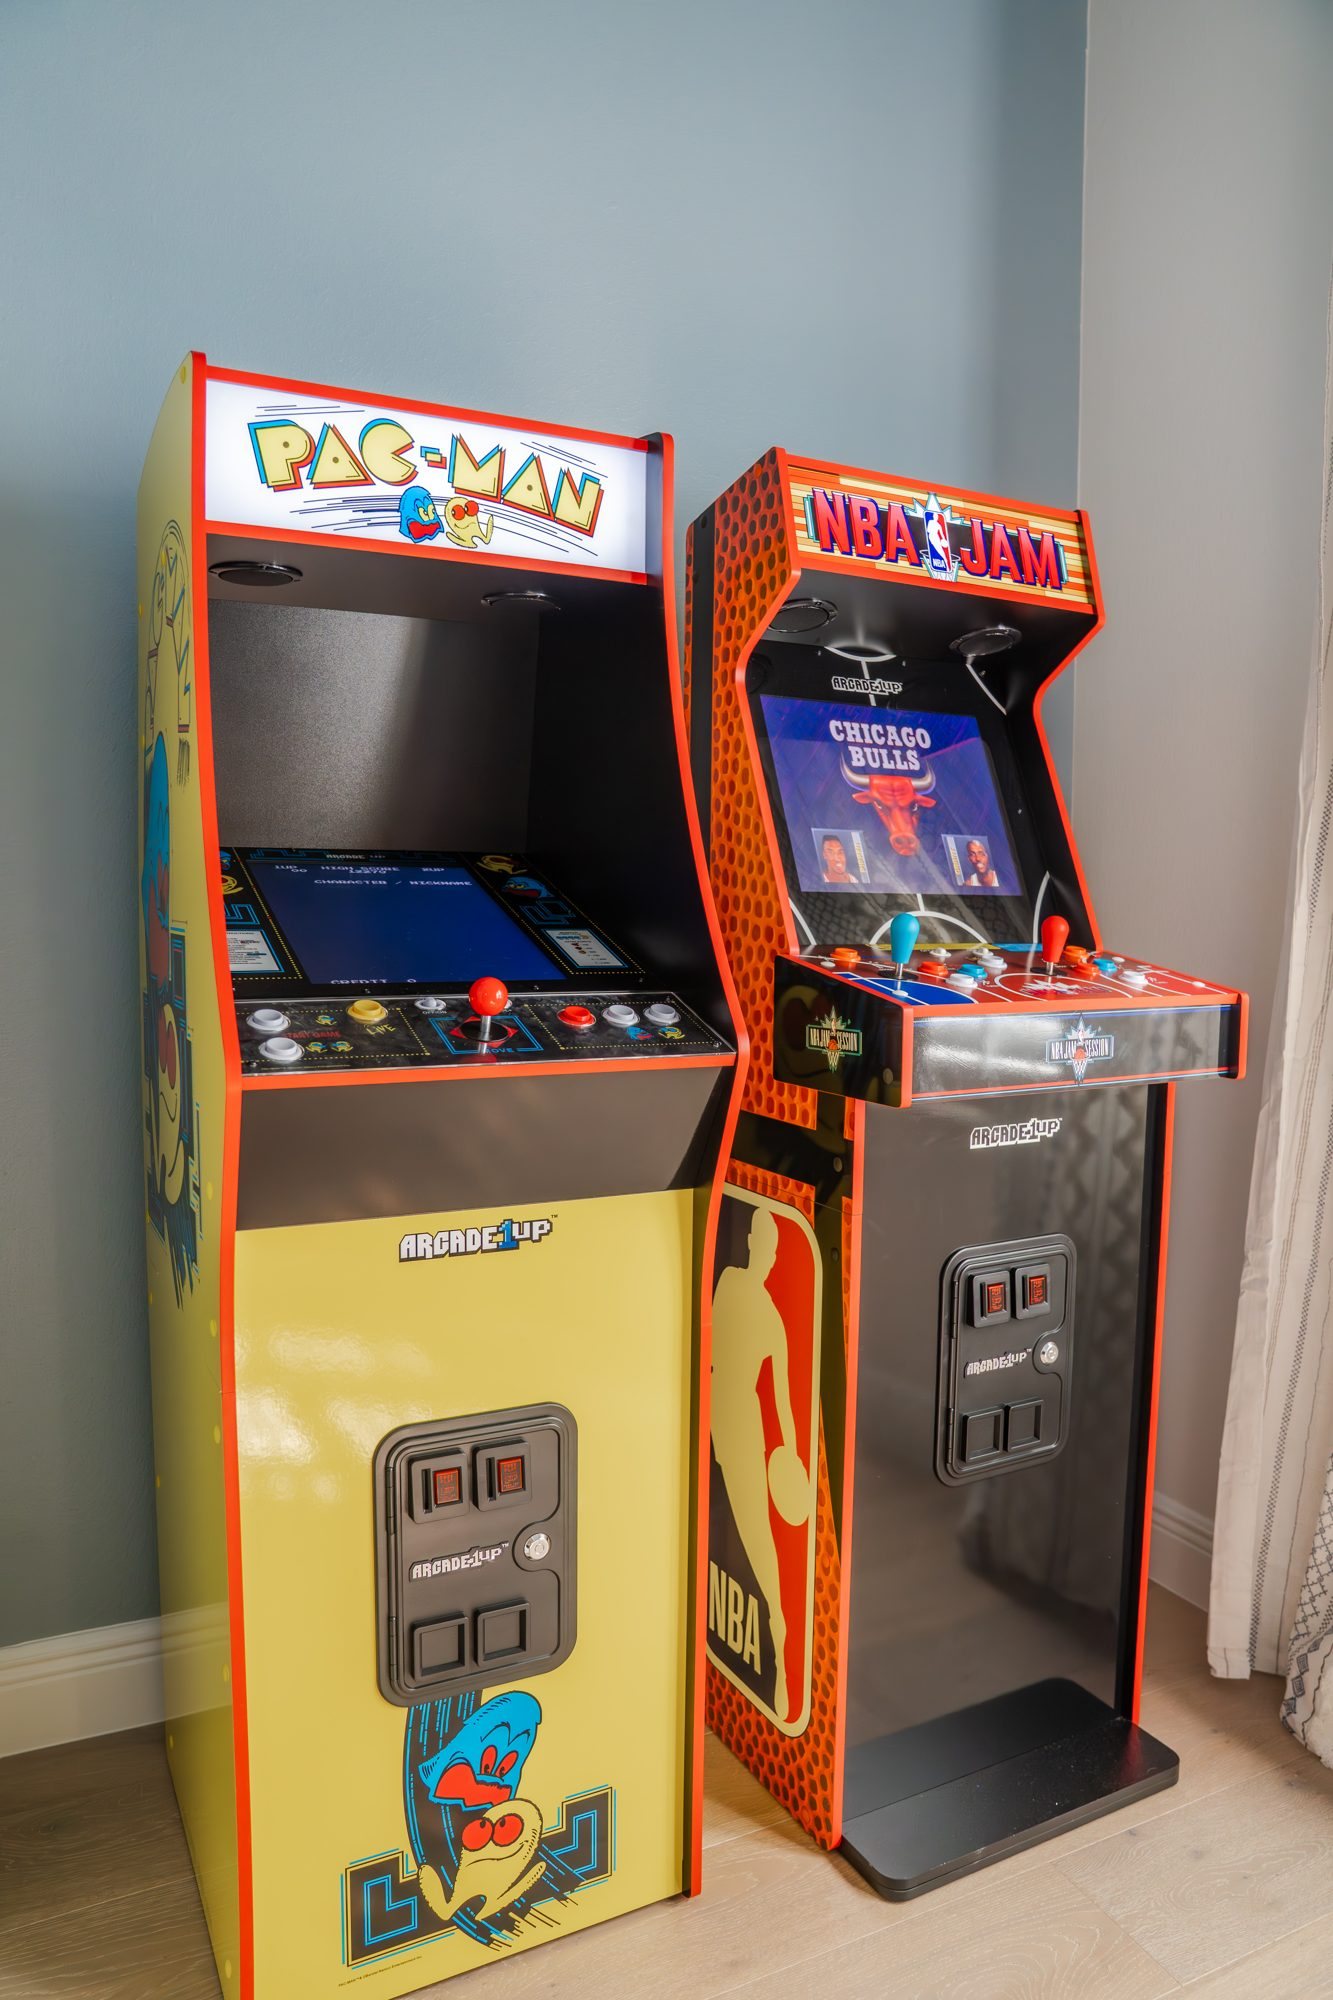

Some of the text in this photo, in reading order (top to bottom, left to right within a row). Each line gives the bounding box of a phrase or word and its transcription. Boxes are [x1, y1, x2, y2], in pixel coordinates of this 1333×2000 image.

[247, 418, 604, 537] PAC-MAN
[811, 487, 1064, 591] NBA JAM
[829, 719, 931, 748] CHICAGO
[848, 746, 920, 771] BULLS
[1051, 1038, 1109, 1060] NBA JAM SESSION
[708, 1561, 761, 1676] NBA
